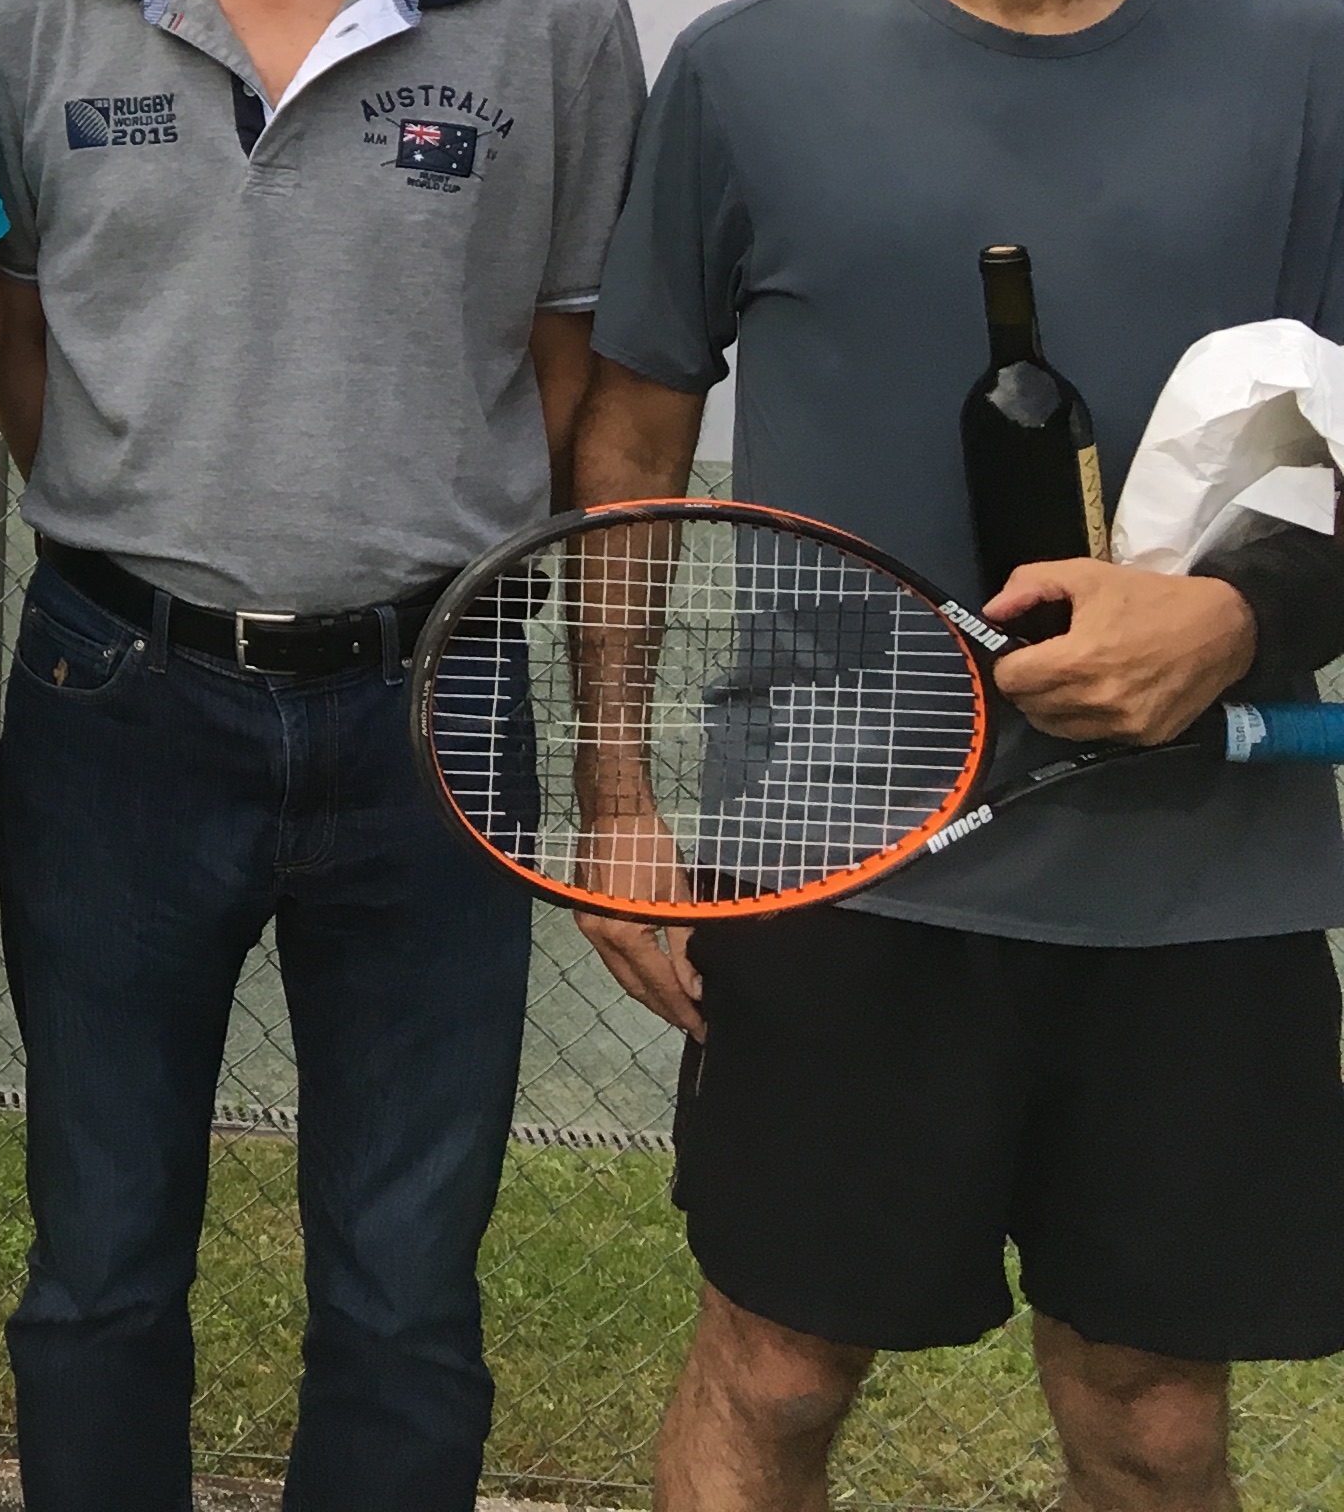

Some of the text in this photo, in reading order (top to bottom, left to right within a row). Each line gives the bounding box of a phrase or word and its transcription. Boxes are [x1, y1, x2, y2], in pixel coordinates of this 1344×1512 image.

[113, 93, 175, 116] RUGBY
[360, 84, 515, 139] AUSTRALIA
[113, 113, 177, 128] WORLD CUP
[111, 125, 179, 146] 2015
[938, 599, 1010, 653] prince
